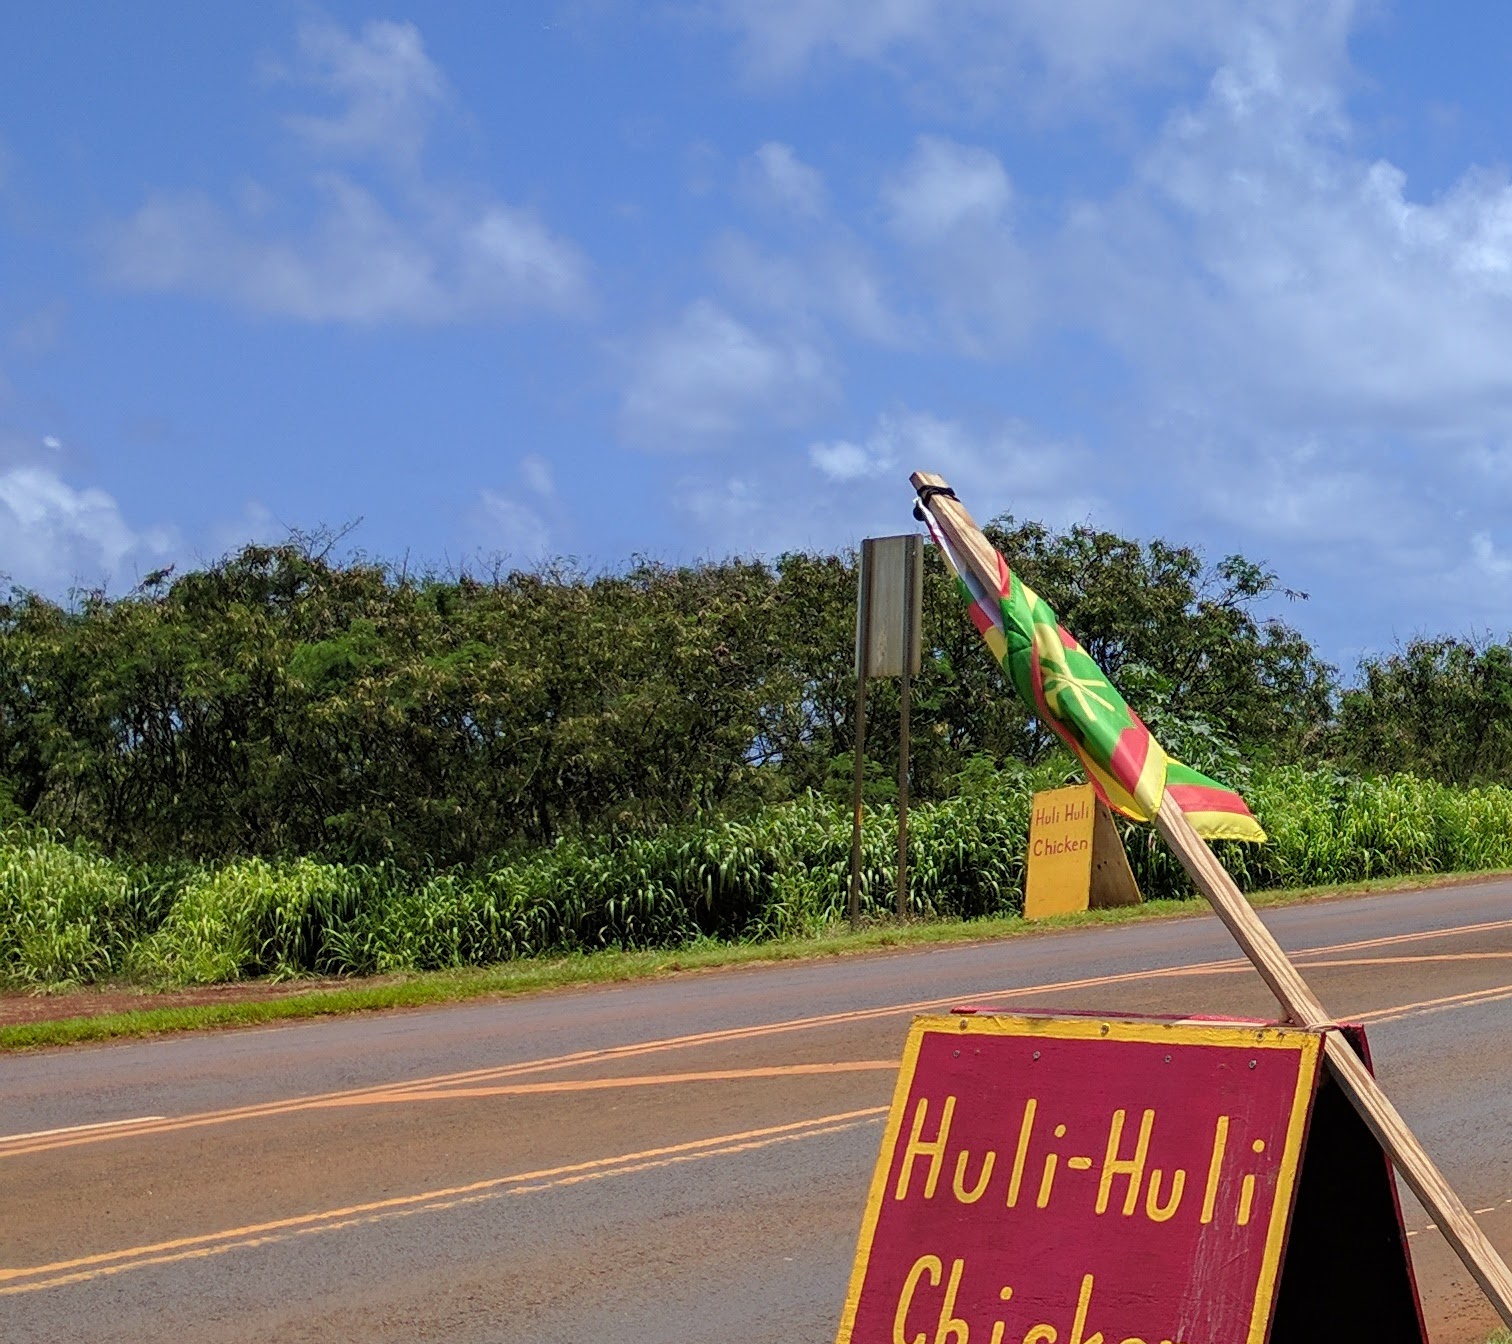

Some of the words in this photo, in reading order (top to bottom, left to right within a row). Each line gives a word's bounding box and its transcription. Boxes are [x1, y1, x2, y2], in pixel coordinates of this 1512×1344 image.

[1035, 805, 1060, 826] Huli
[1064, 800, 1089, 822] Huli
[1033, 834, 1088, 856] Chicken
[895, 1096, 1264, 1225] Huli-Huli
